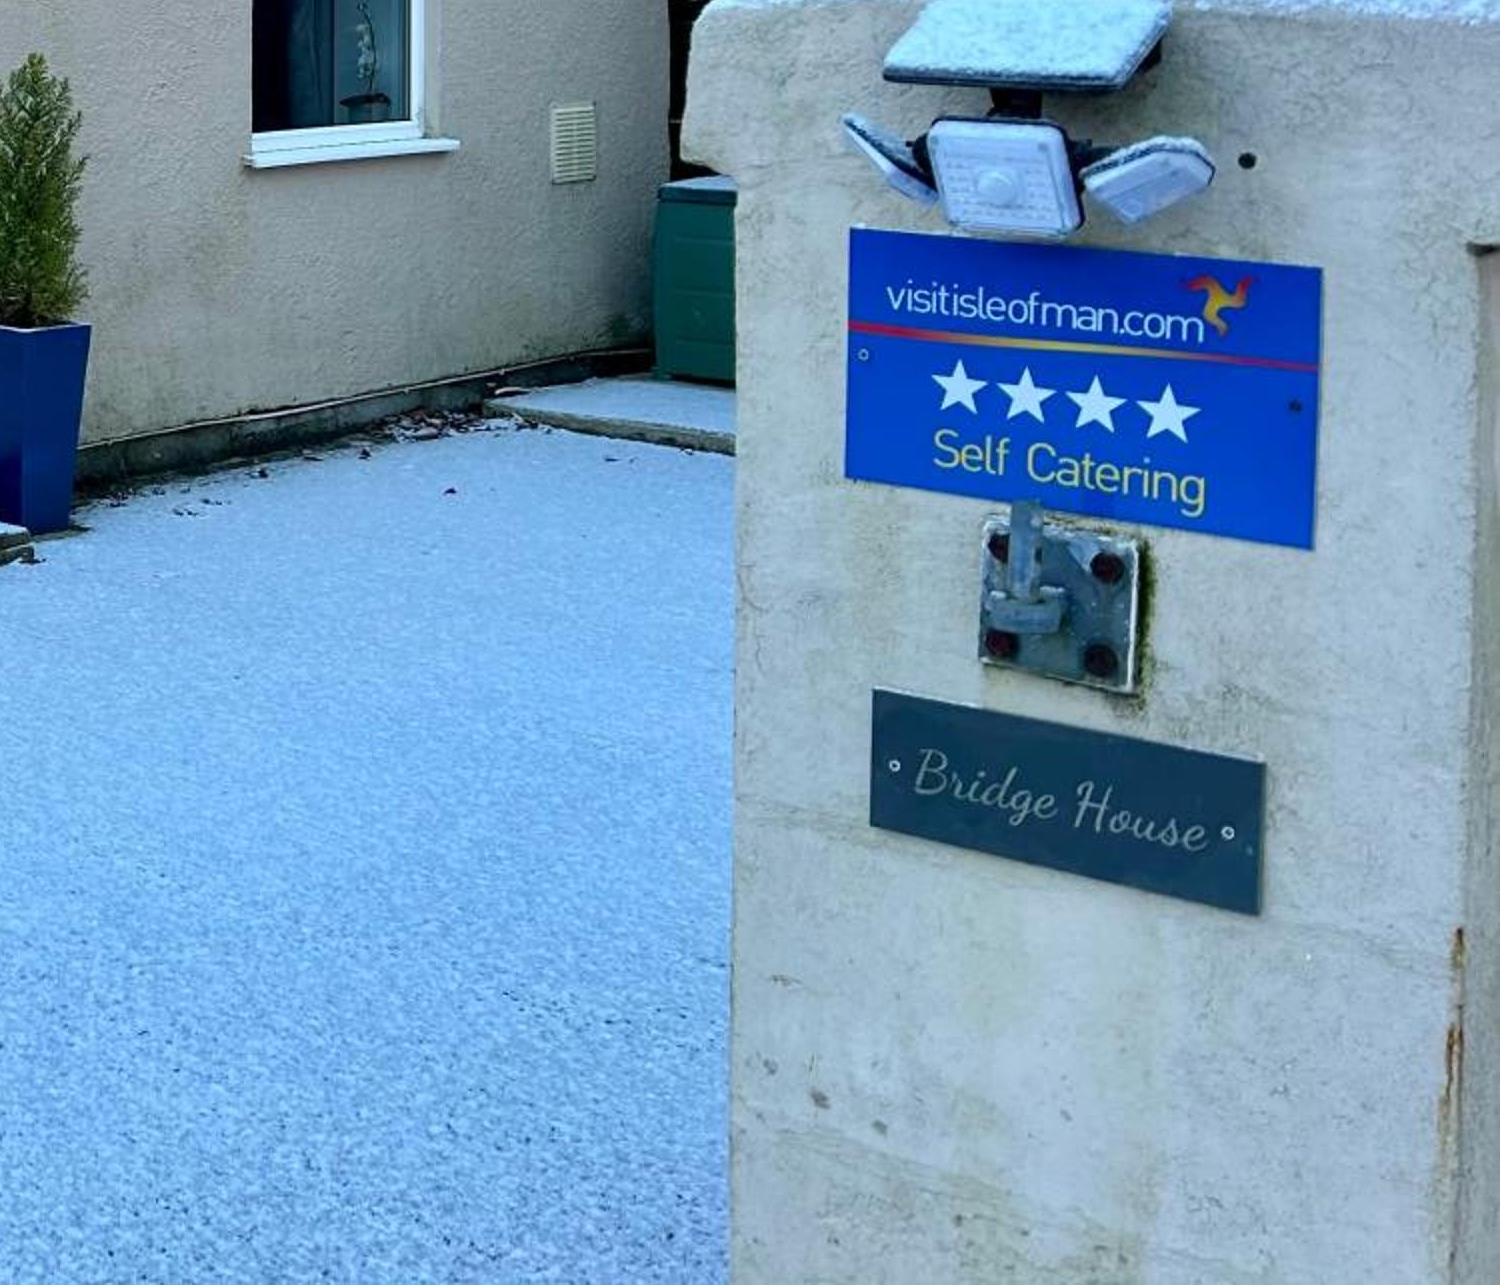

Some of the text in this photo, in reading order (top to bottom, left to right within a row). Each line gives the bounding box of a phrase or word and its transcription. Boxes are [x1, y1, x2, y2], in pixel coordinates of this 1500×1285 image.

[886, 279, 1203, 344] visitisleofman.com
[933, 428, 1206, 517] Self Catering
[914, 747, 1209, 852] Bridge House
